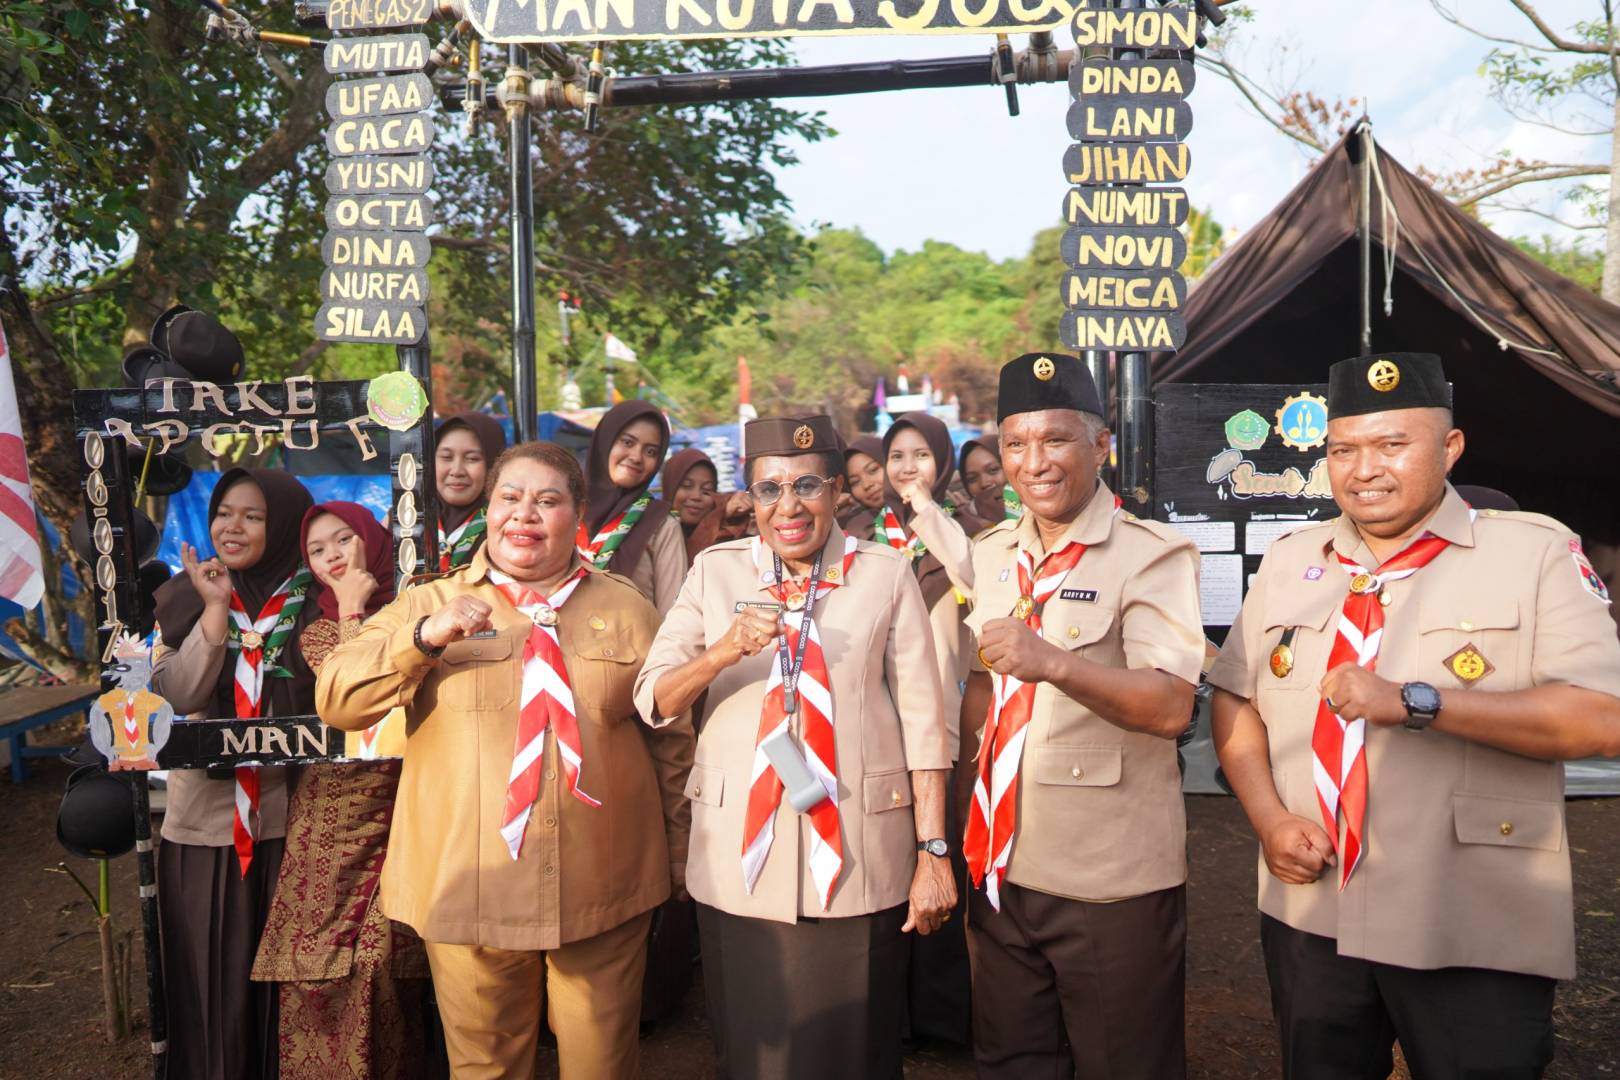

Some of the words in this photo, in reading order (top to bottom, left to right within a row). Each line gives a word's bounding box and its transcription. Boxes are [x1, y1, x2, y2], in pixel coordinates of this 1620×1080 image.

[1076, 11, 1196, 48] SIMON
[331, 41, 423, 69] MUTIA
[1082, 66, 1183, 94] DINDA
[339, 81, 422, 115] UFAA
[335, 119, 425, 152] CACA
[1086, 107, 1175, 136] LANI
[337, 161, 424, 190] YUSNI
[1070, 143, 1188, 182] JIHAN
[335, 199, 424, 227] OCTA
[1068, 191, 1185, 225] NUMUT
[333, 237, 416, 266] DINA
[1079, 235, 1172, 267] NOVI
[329, 272, 420, 301] NURFA
[1069, 276, 1178, 308] MEICA
[326, 307, 415, 339] SILAA
[1077, 316, 1173, 347] INAYA
[145, 375, 316, 416] TAKE
[220, 724, 329, 757] MAN
